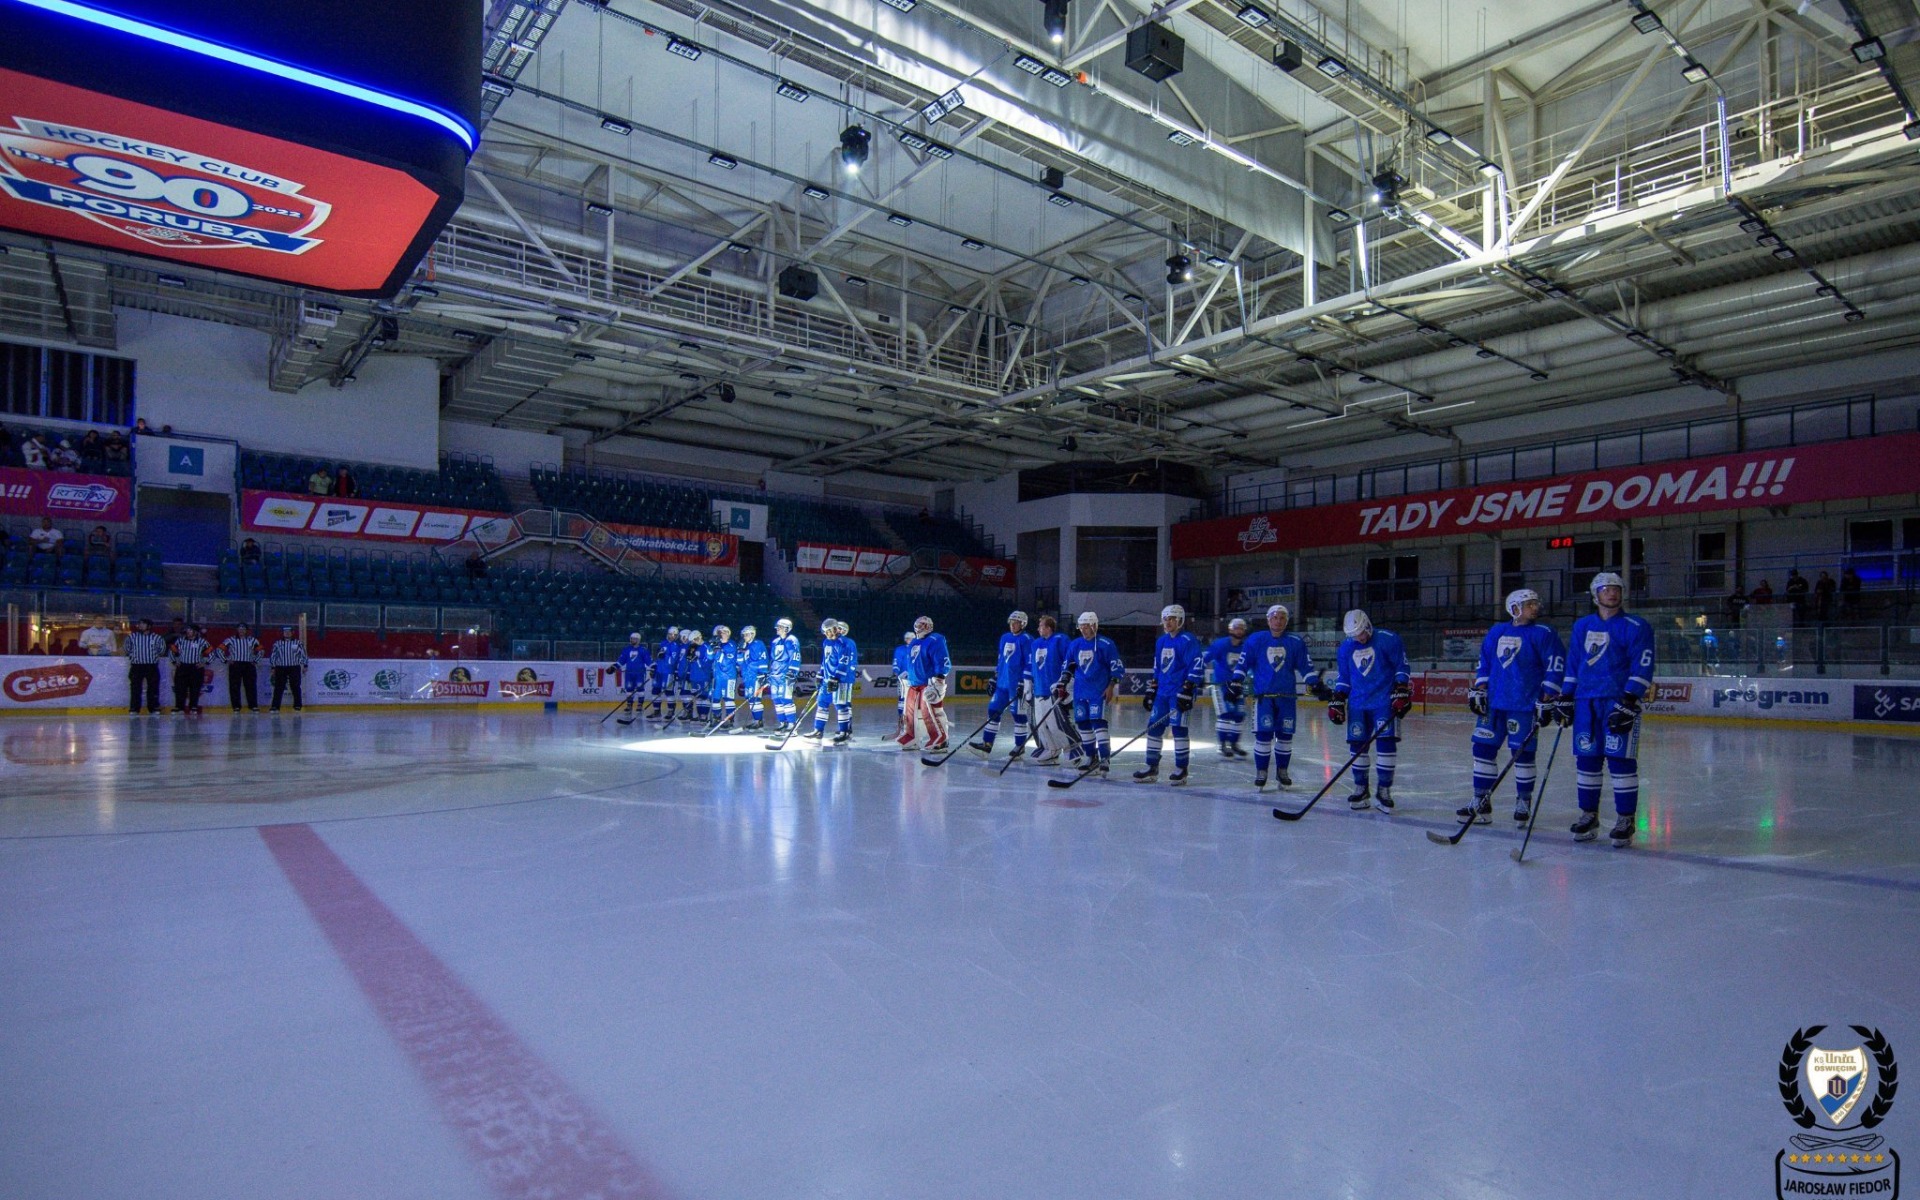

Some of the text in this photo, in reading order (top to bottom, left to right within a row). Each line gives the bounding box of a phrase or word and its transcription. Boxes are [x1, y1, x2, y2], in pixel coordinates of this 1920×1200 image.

[8, 146, 70, 168] 1932
[43, 126, 280, 188] HOCKEY CLUB
[67, 154, 253, 218] 90
[49, 188, 270, 244] PORUBA
[252, 203, 302, 218] 2022
[180, 455, 192, 467] A
[1359, 458, 1796, 535] TADY JSME DOMA!!!
[736, 513, 745, 522] A
[839, 653, 849, 665] 23
[1110, 659, 1124, 672] 24
[1546, 655, 1564, 672] 16
[1640, 649, 1652, 667] 6
[435, 682, 485, 695] OSTRAVAR
[504, 682, 549, 695] OSTRAVAR
[1422, 686, 1450, 695] TADY
[1713, 688, 1829, 709] program
